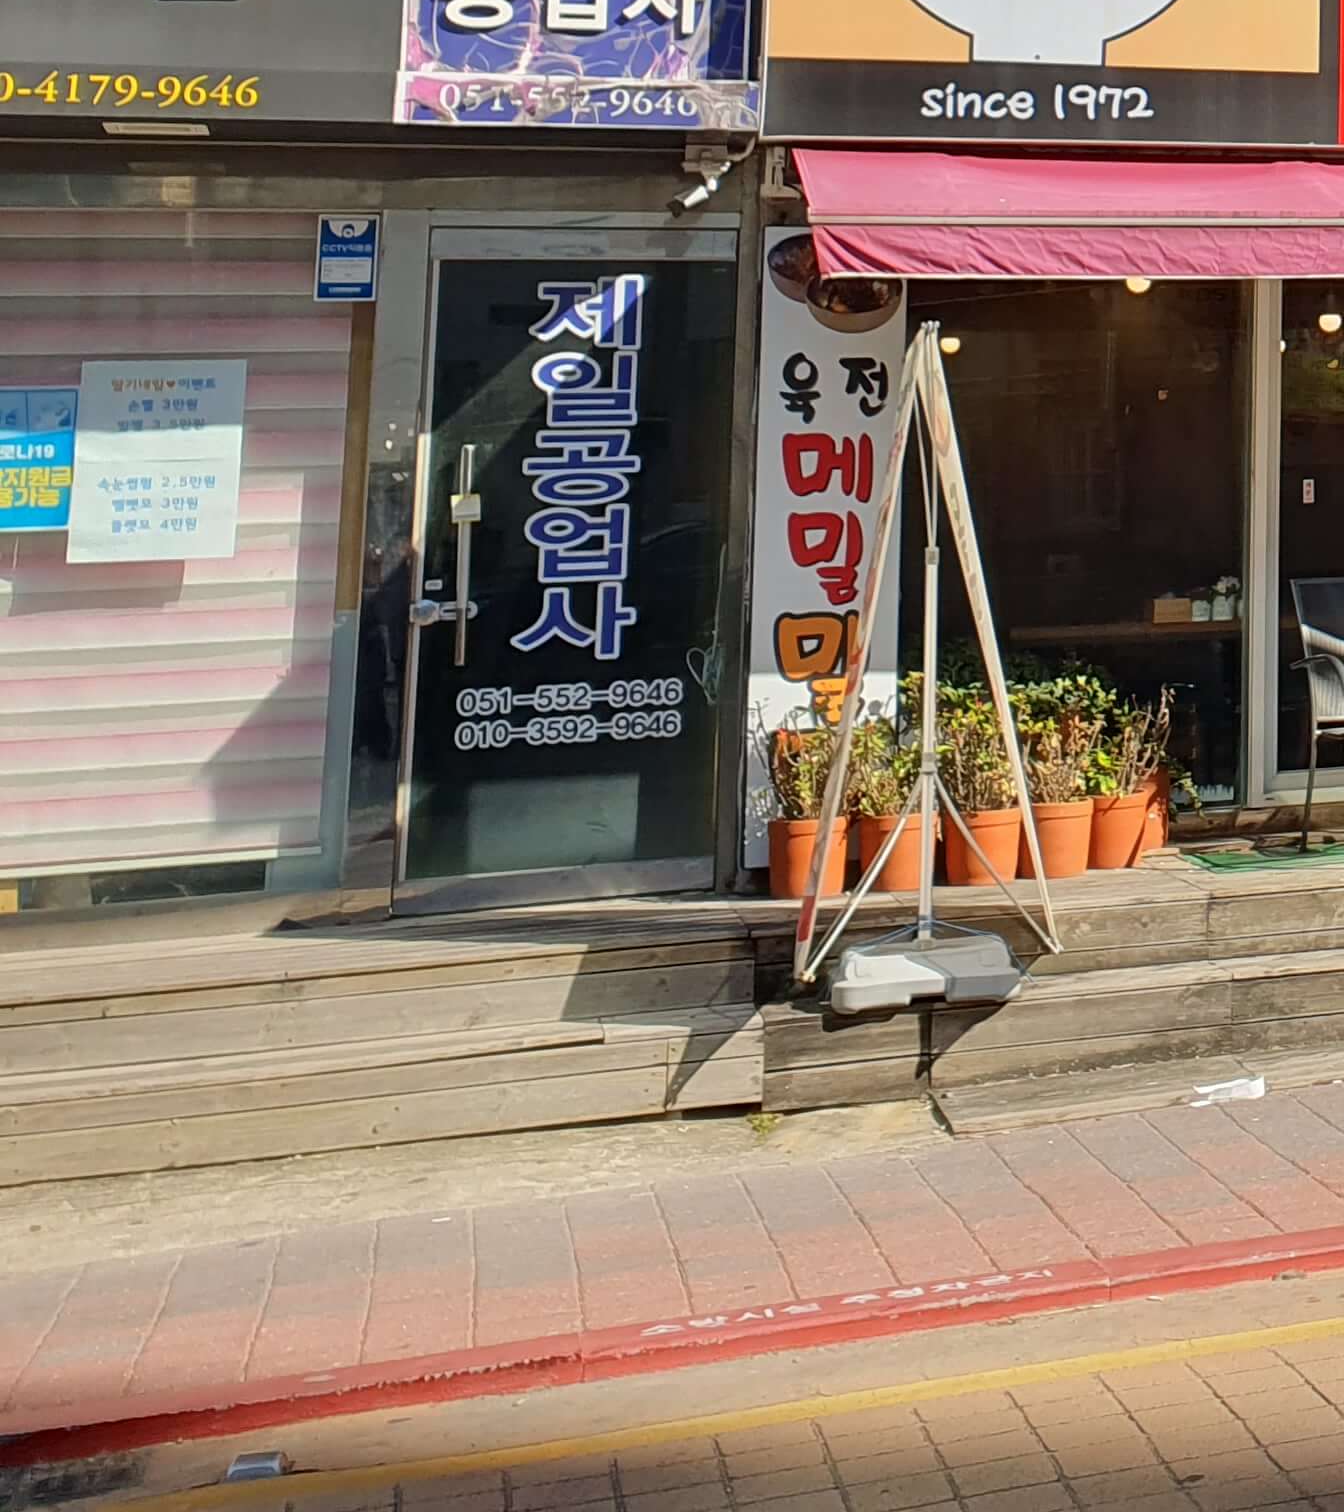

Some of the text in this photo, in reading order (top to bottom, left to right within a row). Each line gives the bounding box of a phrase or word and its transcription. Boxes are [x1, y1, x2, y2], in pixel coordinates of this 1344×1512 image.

[919, 81, 1156, 121] since 1972
[779, 351, 889, 425] 육전
[0, 466, 73, 489] 지원금
[509, 273, 646, 661] 제일공업사
[781, 431, 874, 608] 메밀
[455, 676, 686, 718] 051-552-9646
[454, 711, 682, 750] 010-3592-9646
